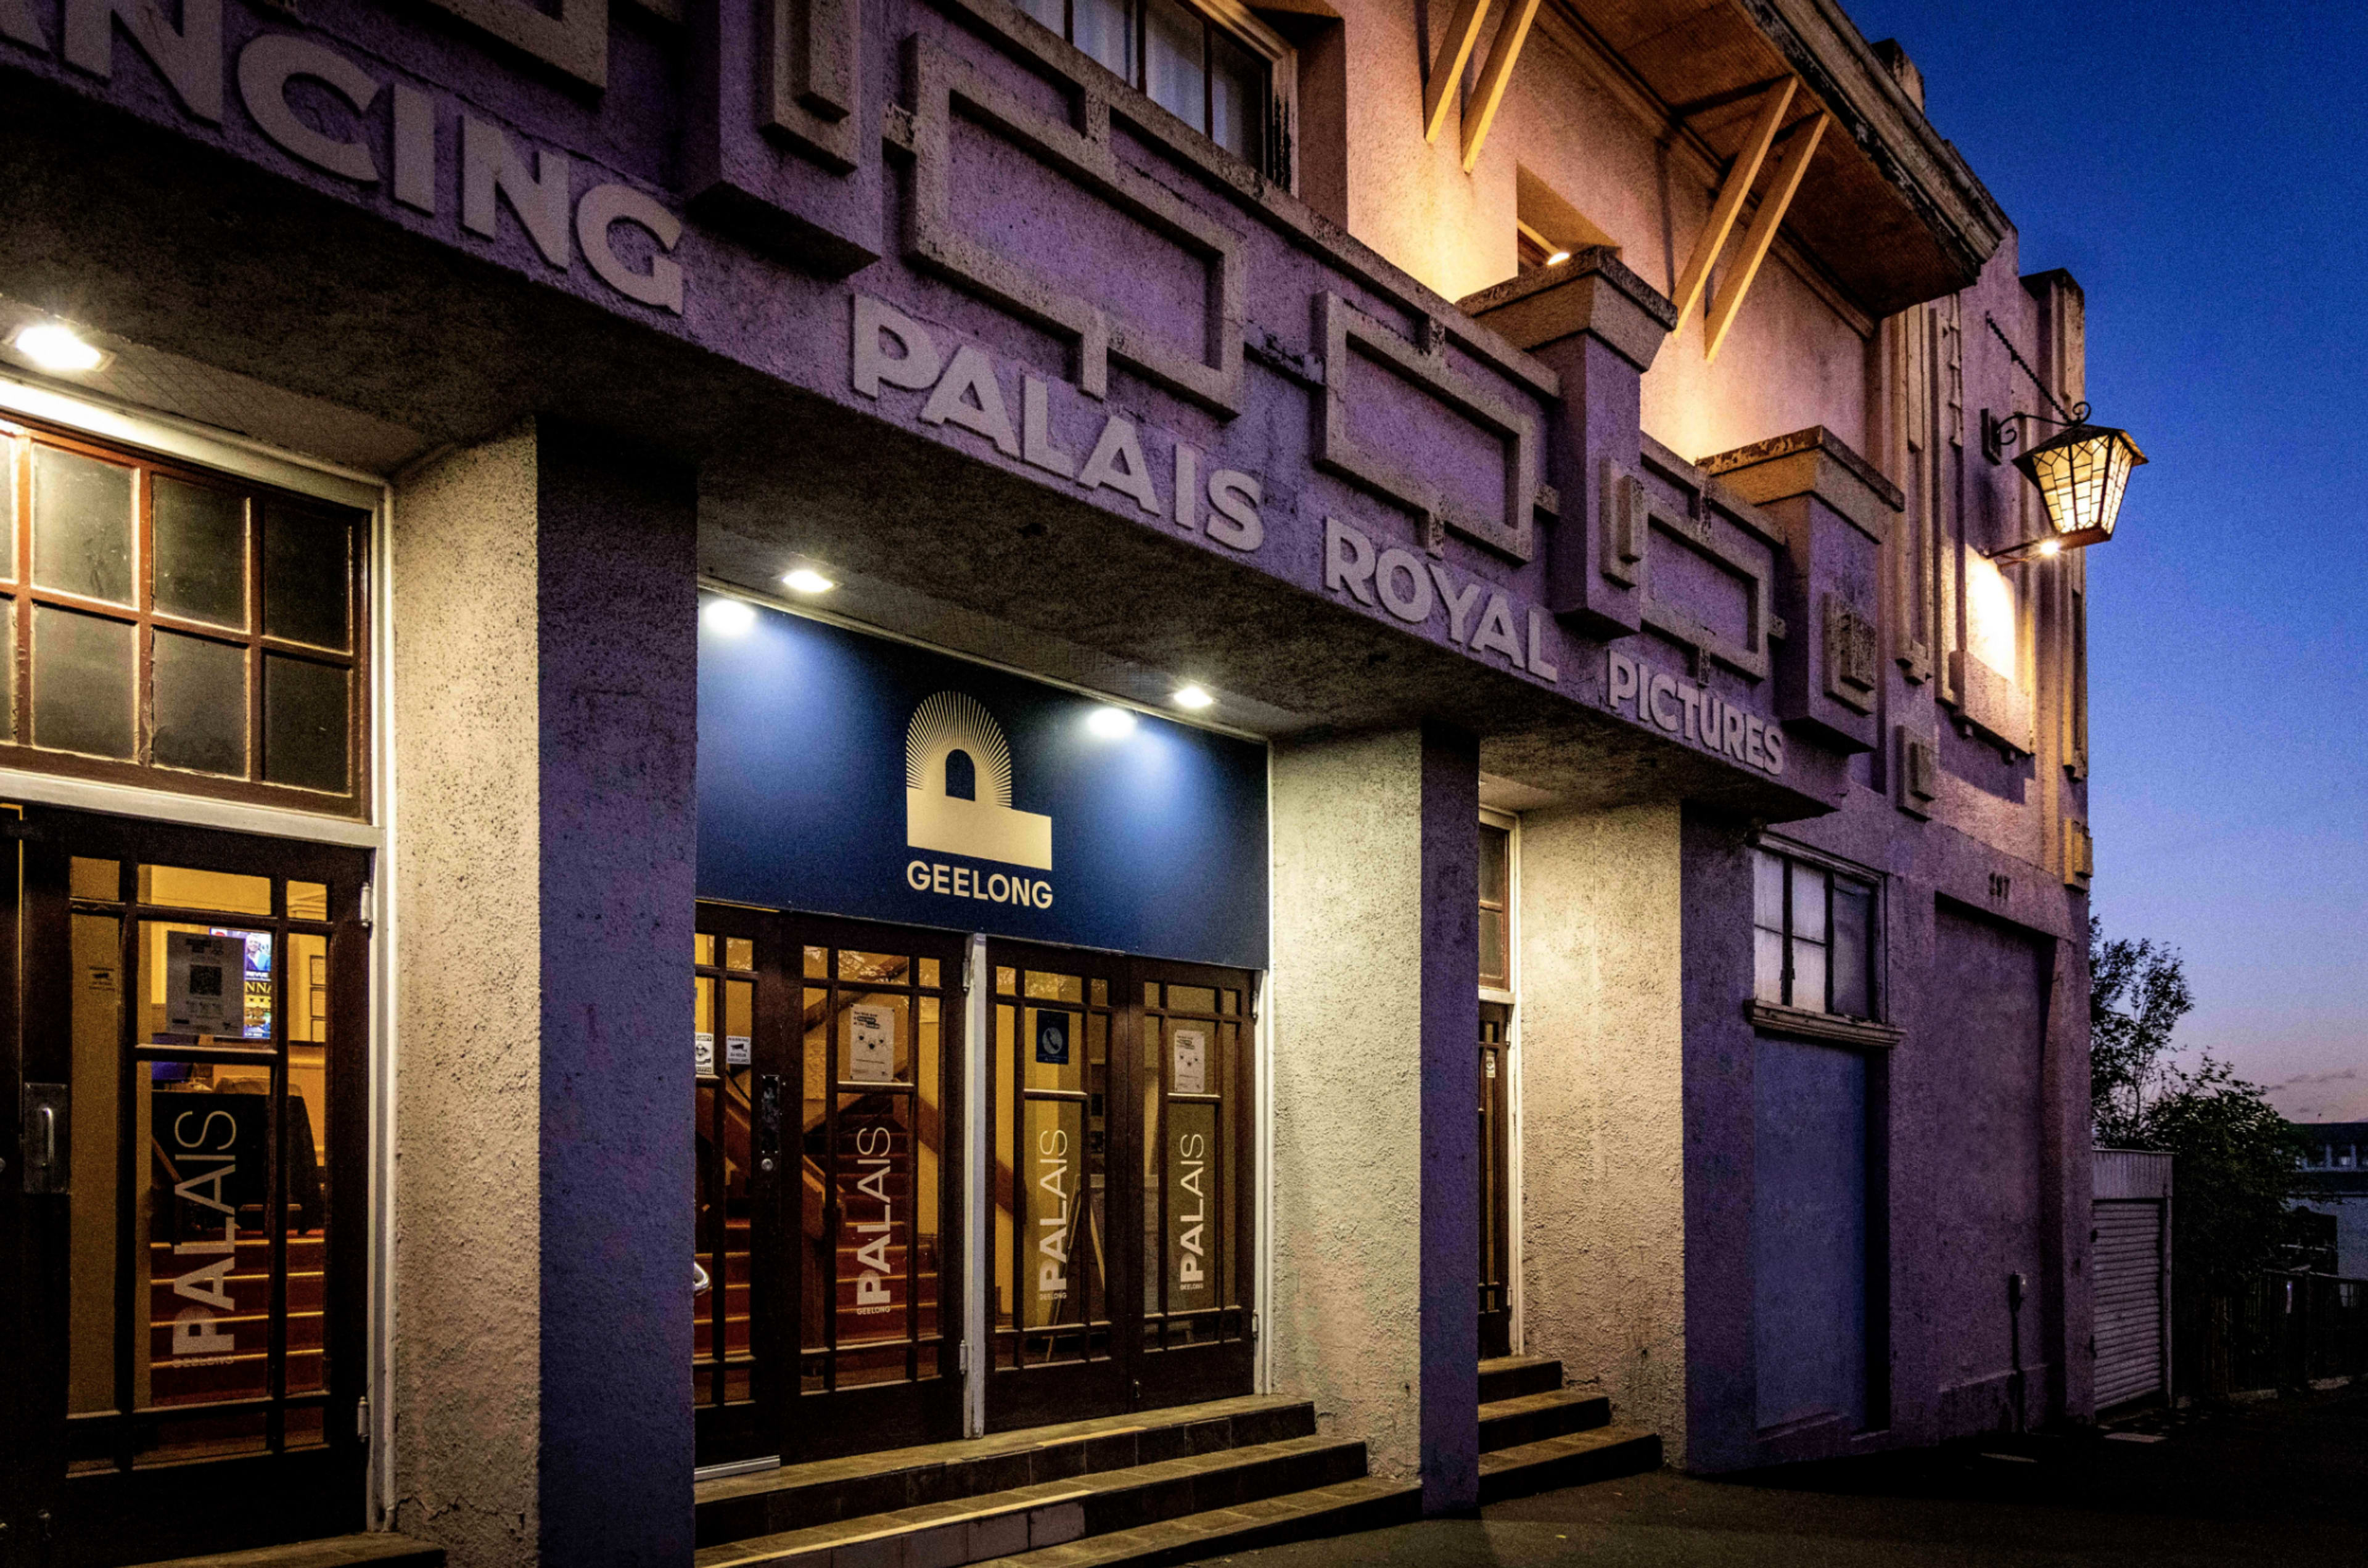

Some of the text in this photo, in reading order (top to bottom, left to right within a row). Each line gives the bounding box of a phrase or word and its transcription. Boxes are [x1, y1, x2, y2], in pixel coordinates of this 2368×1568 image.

[853, 293, 1264, 552] PALAIS
[1324, 517, 1558, 683] ROYAL
[1608, 648, 1784, 776] PICTURES
[906, 860, 1053, 909] GEELONG
[173, 1110, 237, 1355] PALAIS
[857, 1126, 890, 1306] PALAIS
[1039, 1128, 1067, 1292] PALAIS
[1180, 1133, 1204, 1283] PALAIS
[857, 1305, 890, 1315] GEELONG
